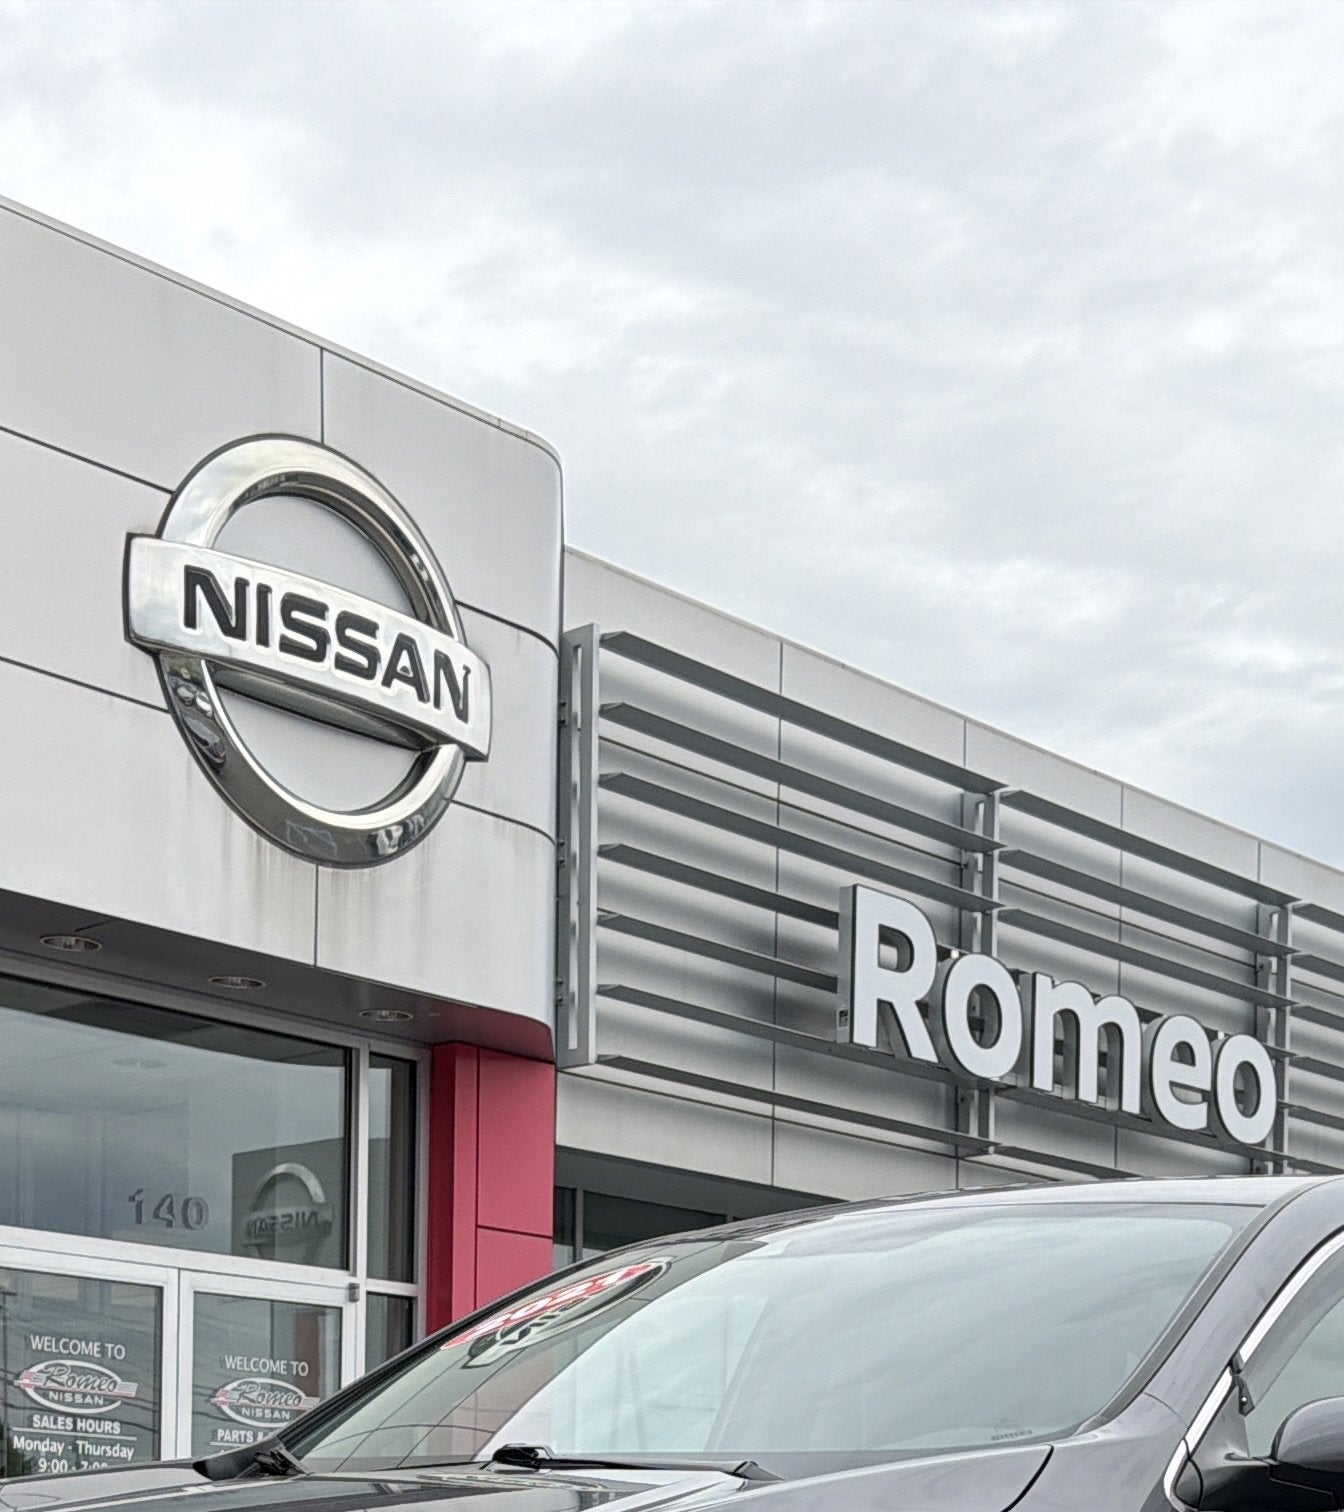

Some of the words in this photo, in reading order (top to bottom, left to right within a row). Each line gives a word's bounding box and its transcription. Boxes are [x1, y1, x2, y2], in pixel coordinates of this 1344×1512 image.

[182, 564, 472, 724] NISSAN
[839, 884, 1278, 1145] Romeo
[128, 1188, 209, 1231] 140
[460, 1268, 627, 1338] 2021
[29, 1334, 101, 1358] WELCOME
[105, 1343, 126, 1360] TO
[41, 1363, 119, 1392] Romeo
[224, 1355, 287, 1375] WELCOME
[290, 1361, 309, 1376] TO
[48, 1391, 104, 1405] NISSAN
[235, 1381, 303, 1407] Romeo
[32, 1414, 73, 1430] SALES
[77, 1418, 121, 1434] HOURS
[241, 1407, 290, 1420] NISSAN
[13, 1435, 65, 1455] Monday
[76, 1440, 135, 1461] Thursday
[217, 1428, 254, 1443] PARTS
[38, 1457, 68, 1473] 9:00
